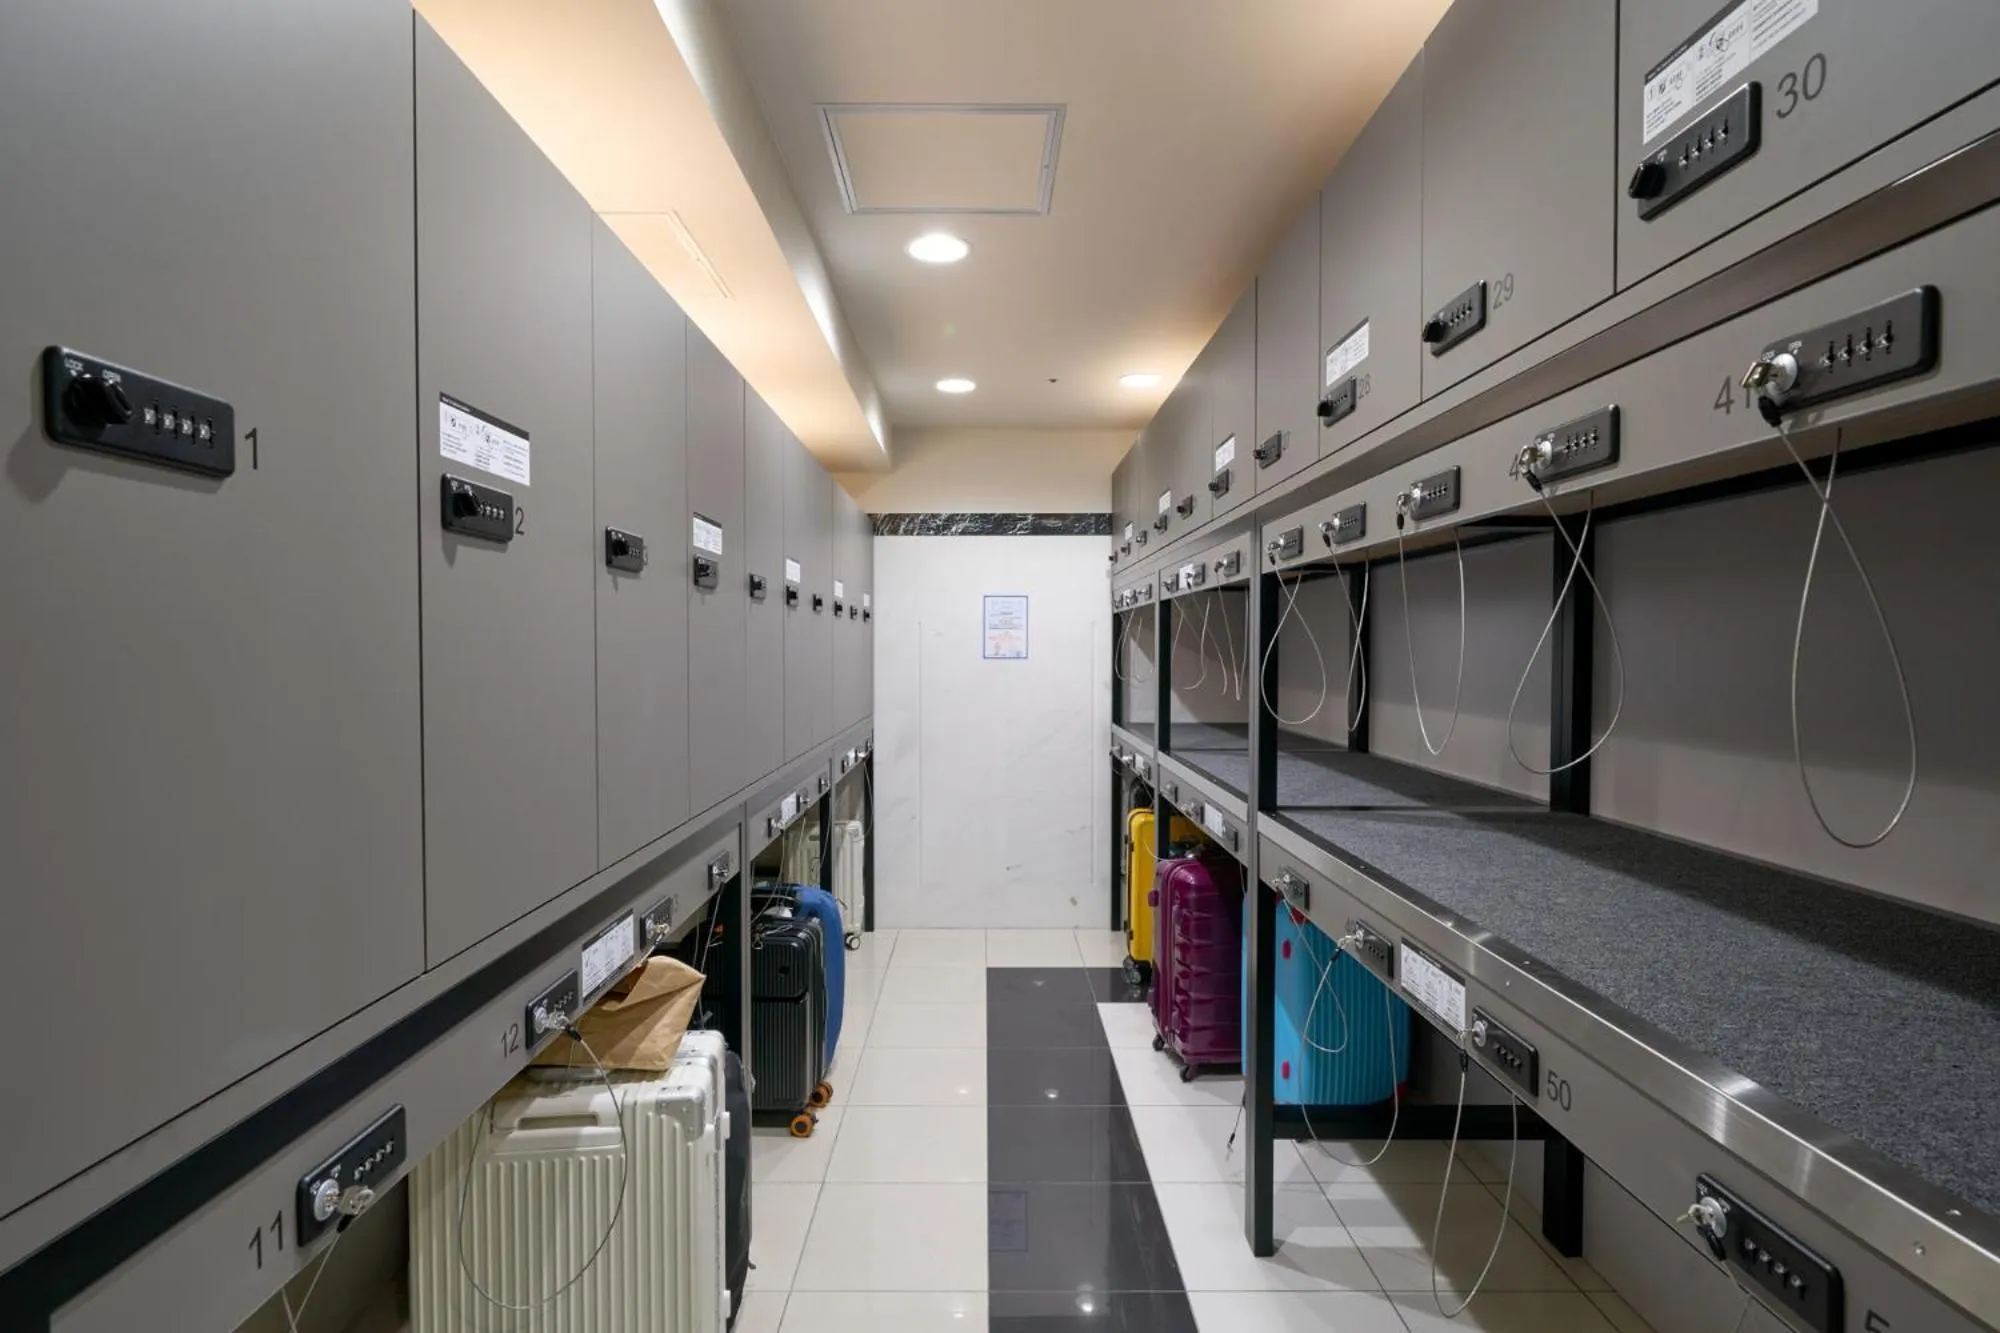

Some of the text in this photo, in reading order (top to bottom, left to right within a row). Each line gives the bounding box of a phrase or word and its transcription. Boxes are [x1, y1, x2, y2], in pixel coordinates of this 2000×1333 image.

[1776, 53, 1826, 118] 30
[1493, 272, 1514, 310] 29
[64, 357, 84, 371] LOCK
[244, 427, 258, 470] 1
[515, 506, 525, 536] 2
[500, 1022, 520, 1059] 12
[1547, 1070, 1572, 1112] 50
[248, 1210, 283, 1270] 11
